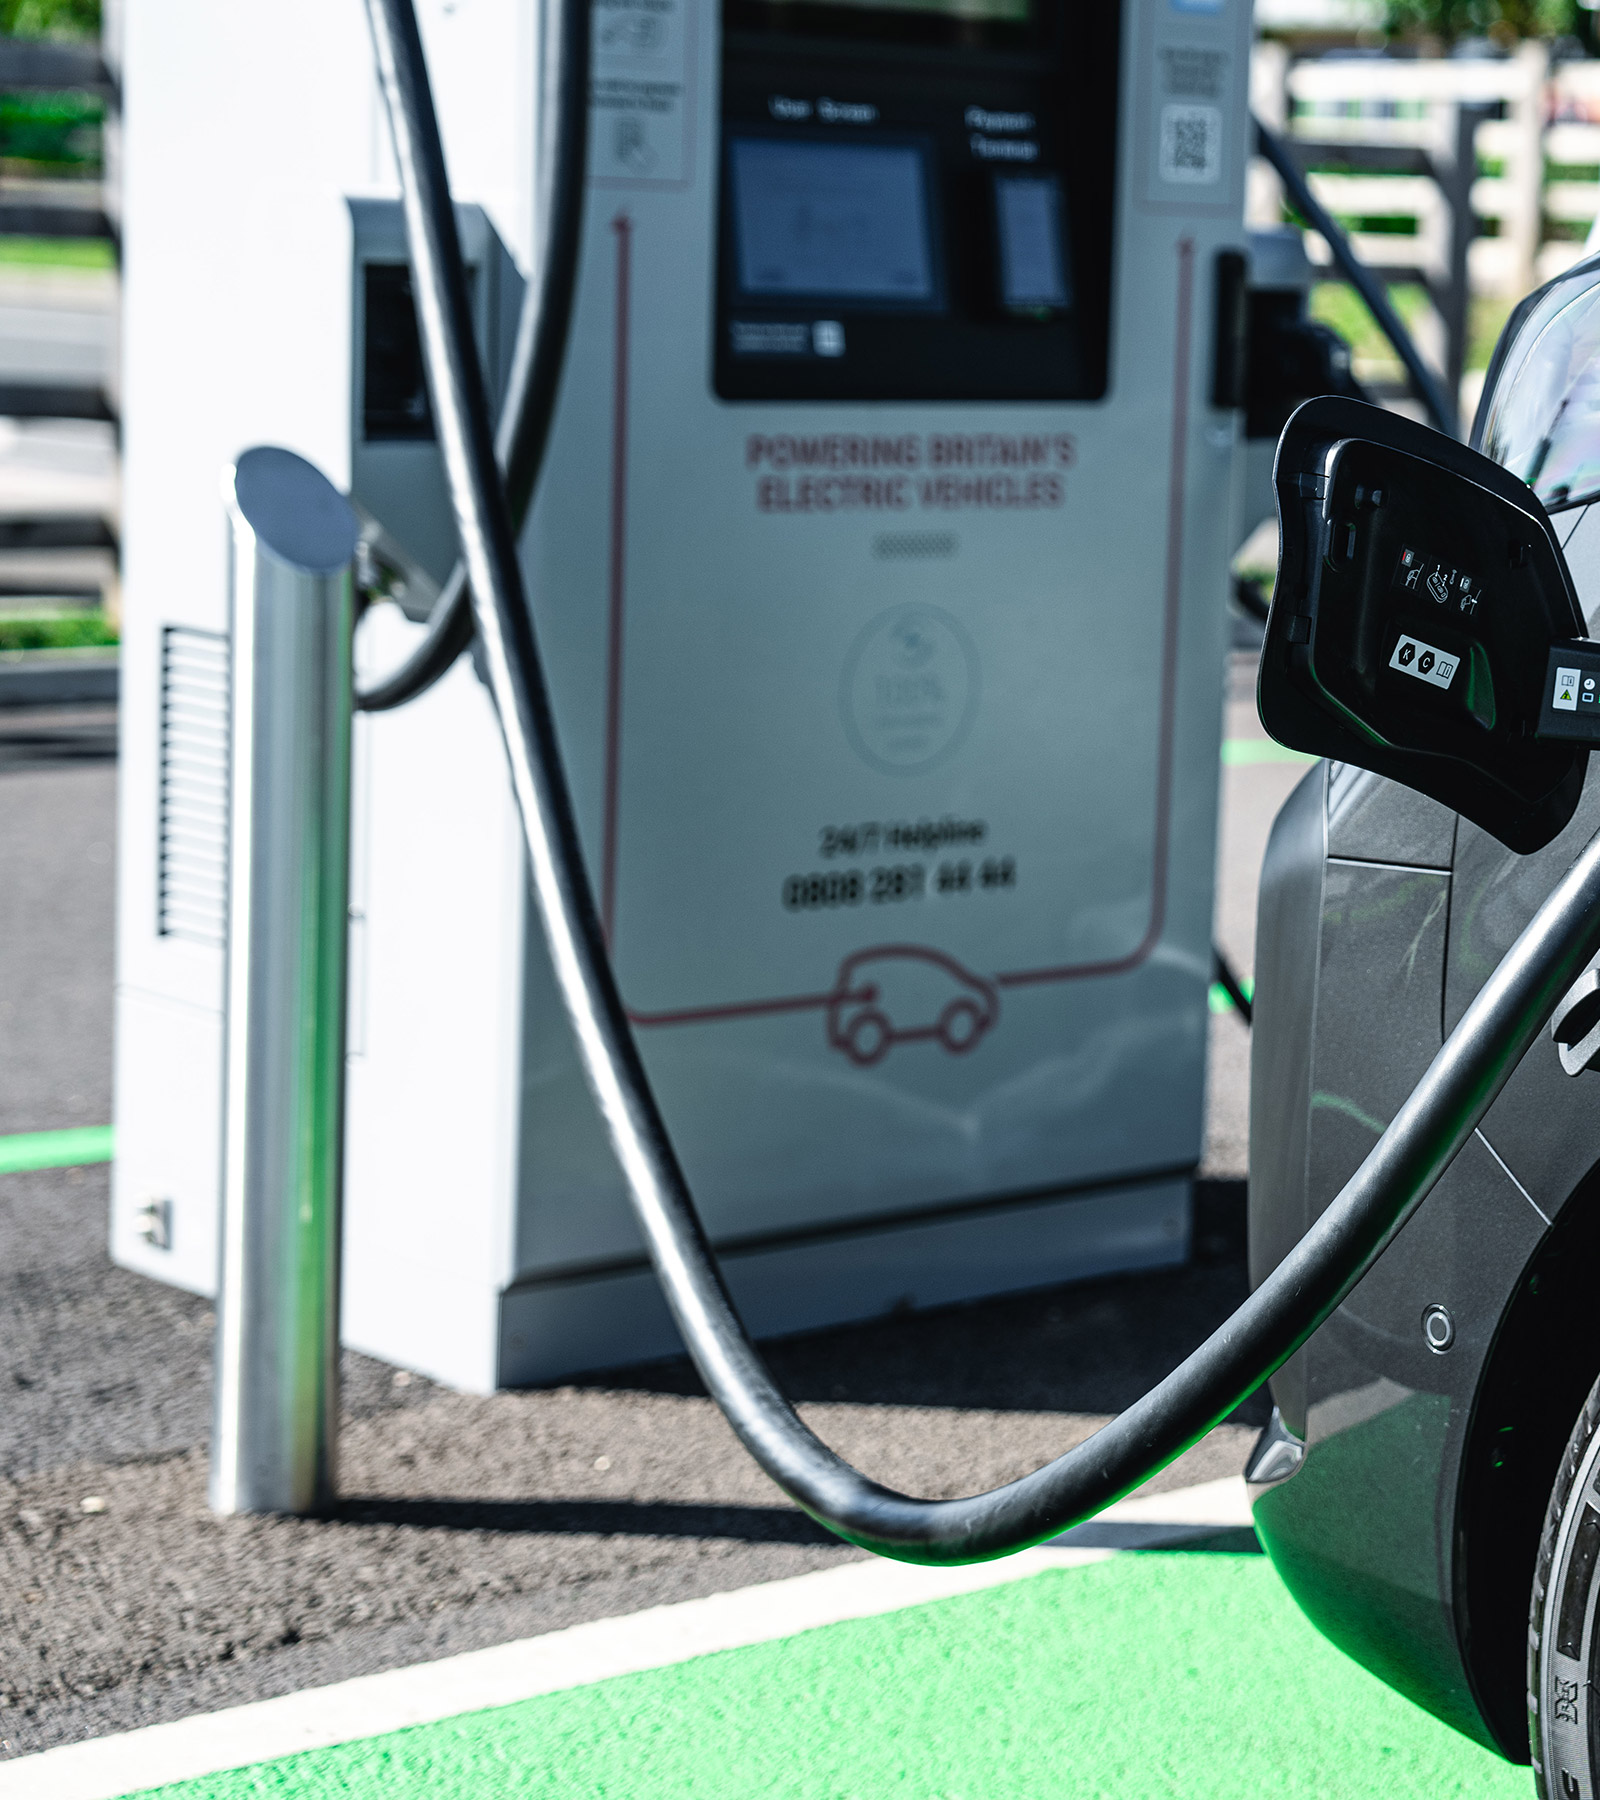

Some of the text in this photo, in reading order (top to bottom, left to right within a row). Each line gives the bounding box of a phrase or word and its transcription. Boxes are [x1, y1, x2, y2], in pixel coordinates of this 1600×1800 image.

[746, 433, 1077, 469] POWERING BRITAIN'S
[757, 471, 1066, 512] ELECTRIC VEHICLES
